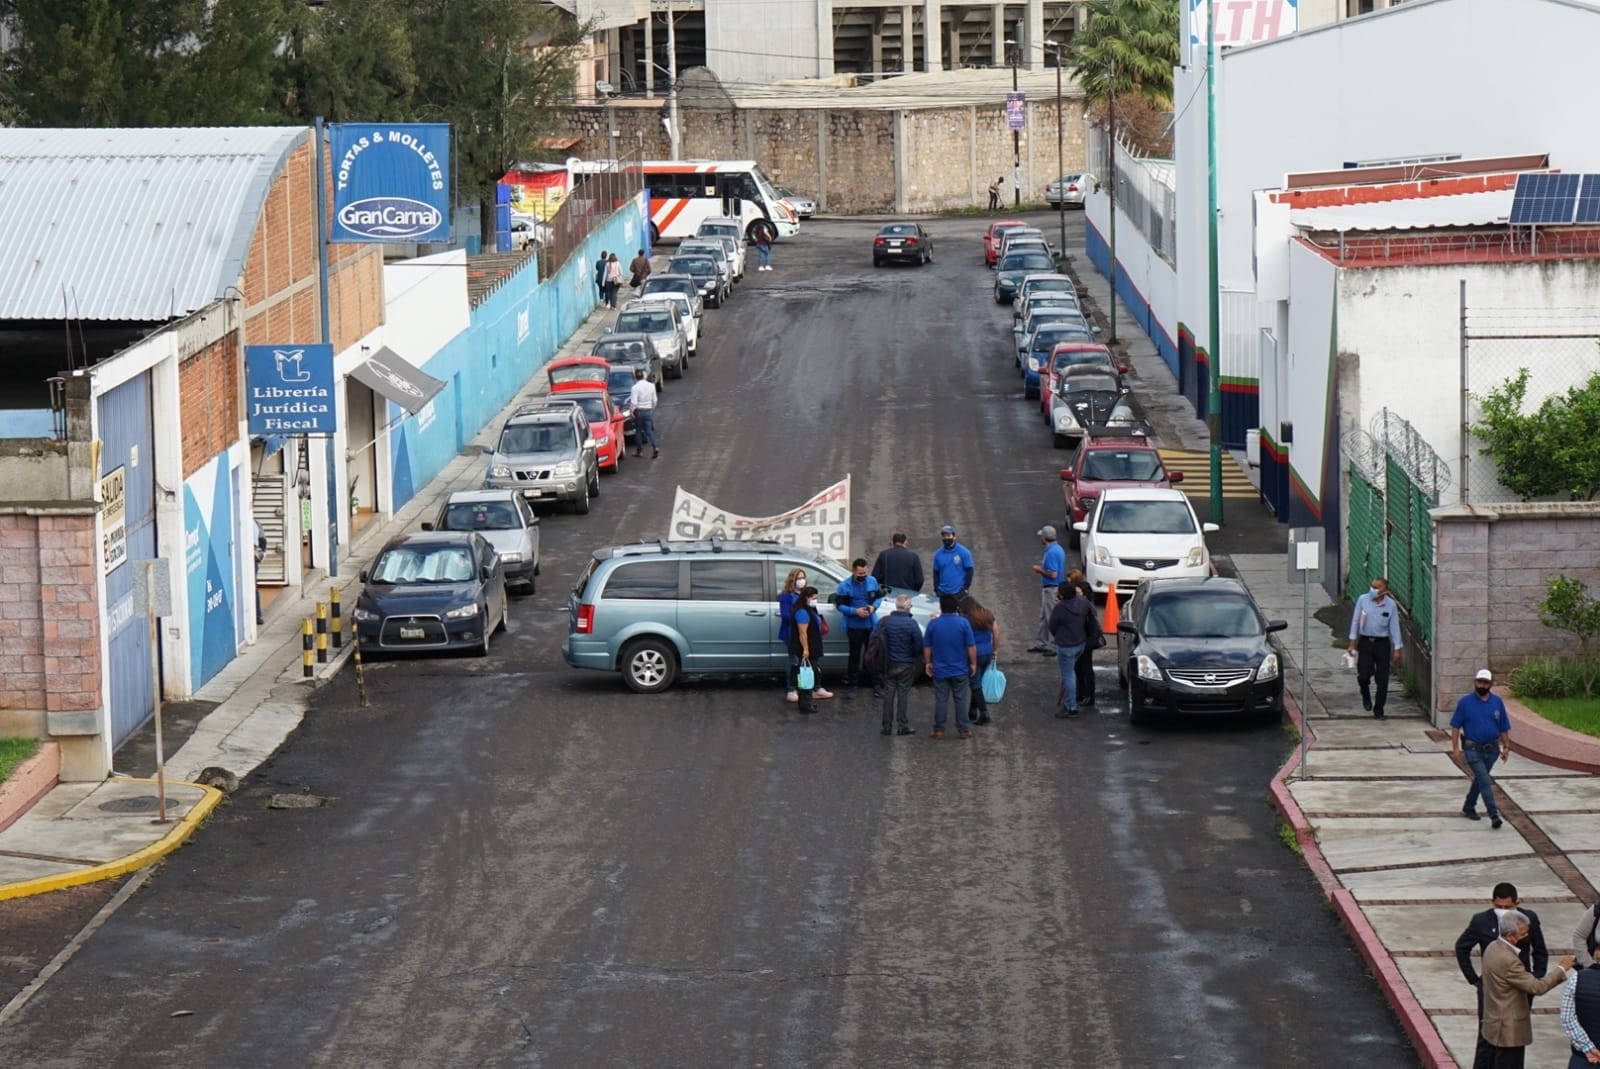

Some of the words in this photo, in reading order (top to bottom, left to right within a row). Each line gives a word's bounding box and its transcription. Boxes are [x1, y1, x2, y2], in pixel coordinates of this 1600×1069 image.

[1205, 0, 1283, 41] LTH
[338, 137, 370, 190] TORTAS
[373, 131, 383, 143] &
[389, 131, 443, 191] MOLLETES
[254, 386, 328, 398] Librería
[254, 402, 328, 416] Jurídica
[265, 418, 318, 429] Fiscal
[102, 474, 123, 506] SALIDA
